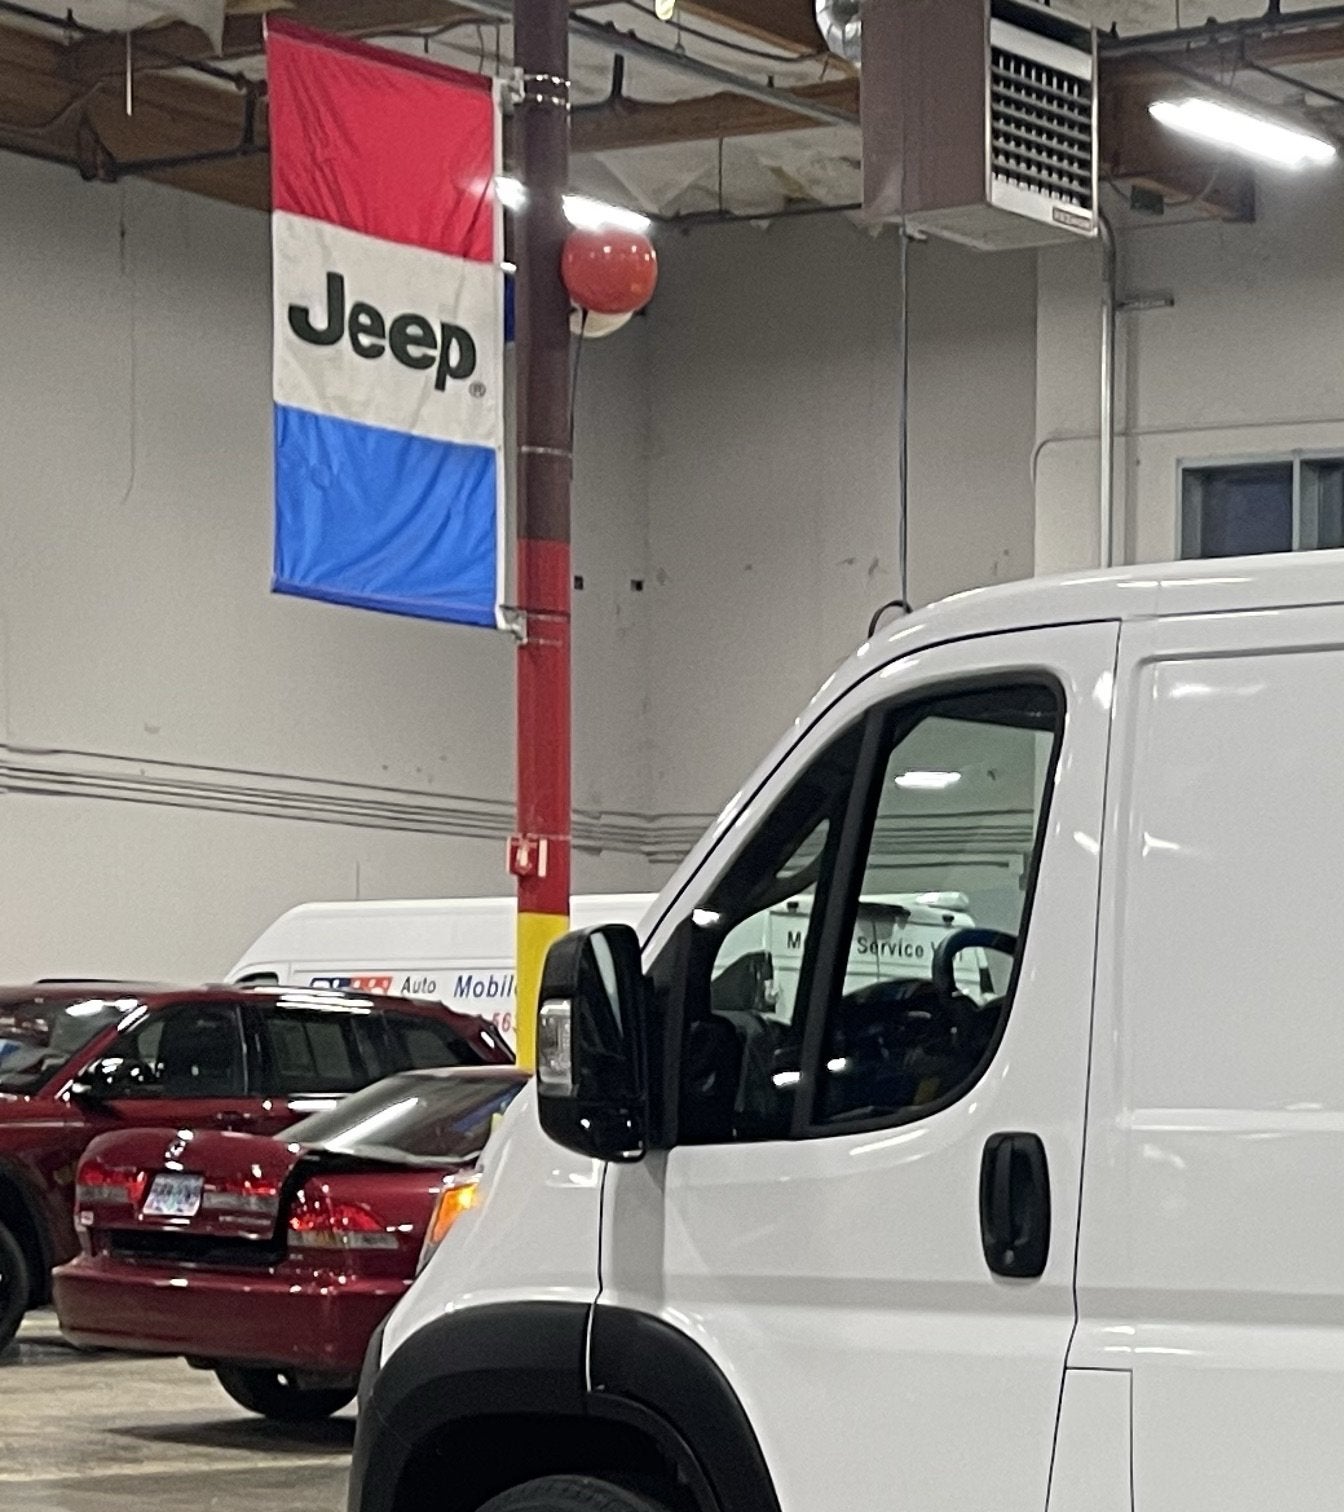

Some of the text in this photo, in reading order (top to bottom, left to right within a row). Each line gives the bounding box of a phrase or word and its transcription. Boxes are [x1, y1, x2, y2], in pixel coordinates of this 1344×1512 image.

[288, 271, 476, 392] Jeep
[400, 976, 437, 995] Auto
[453, 974, 518, 998] Mobil
